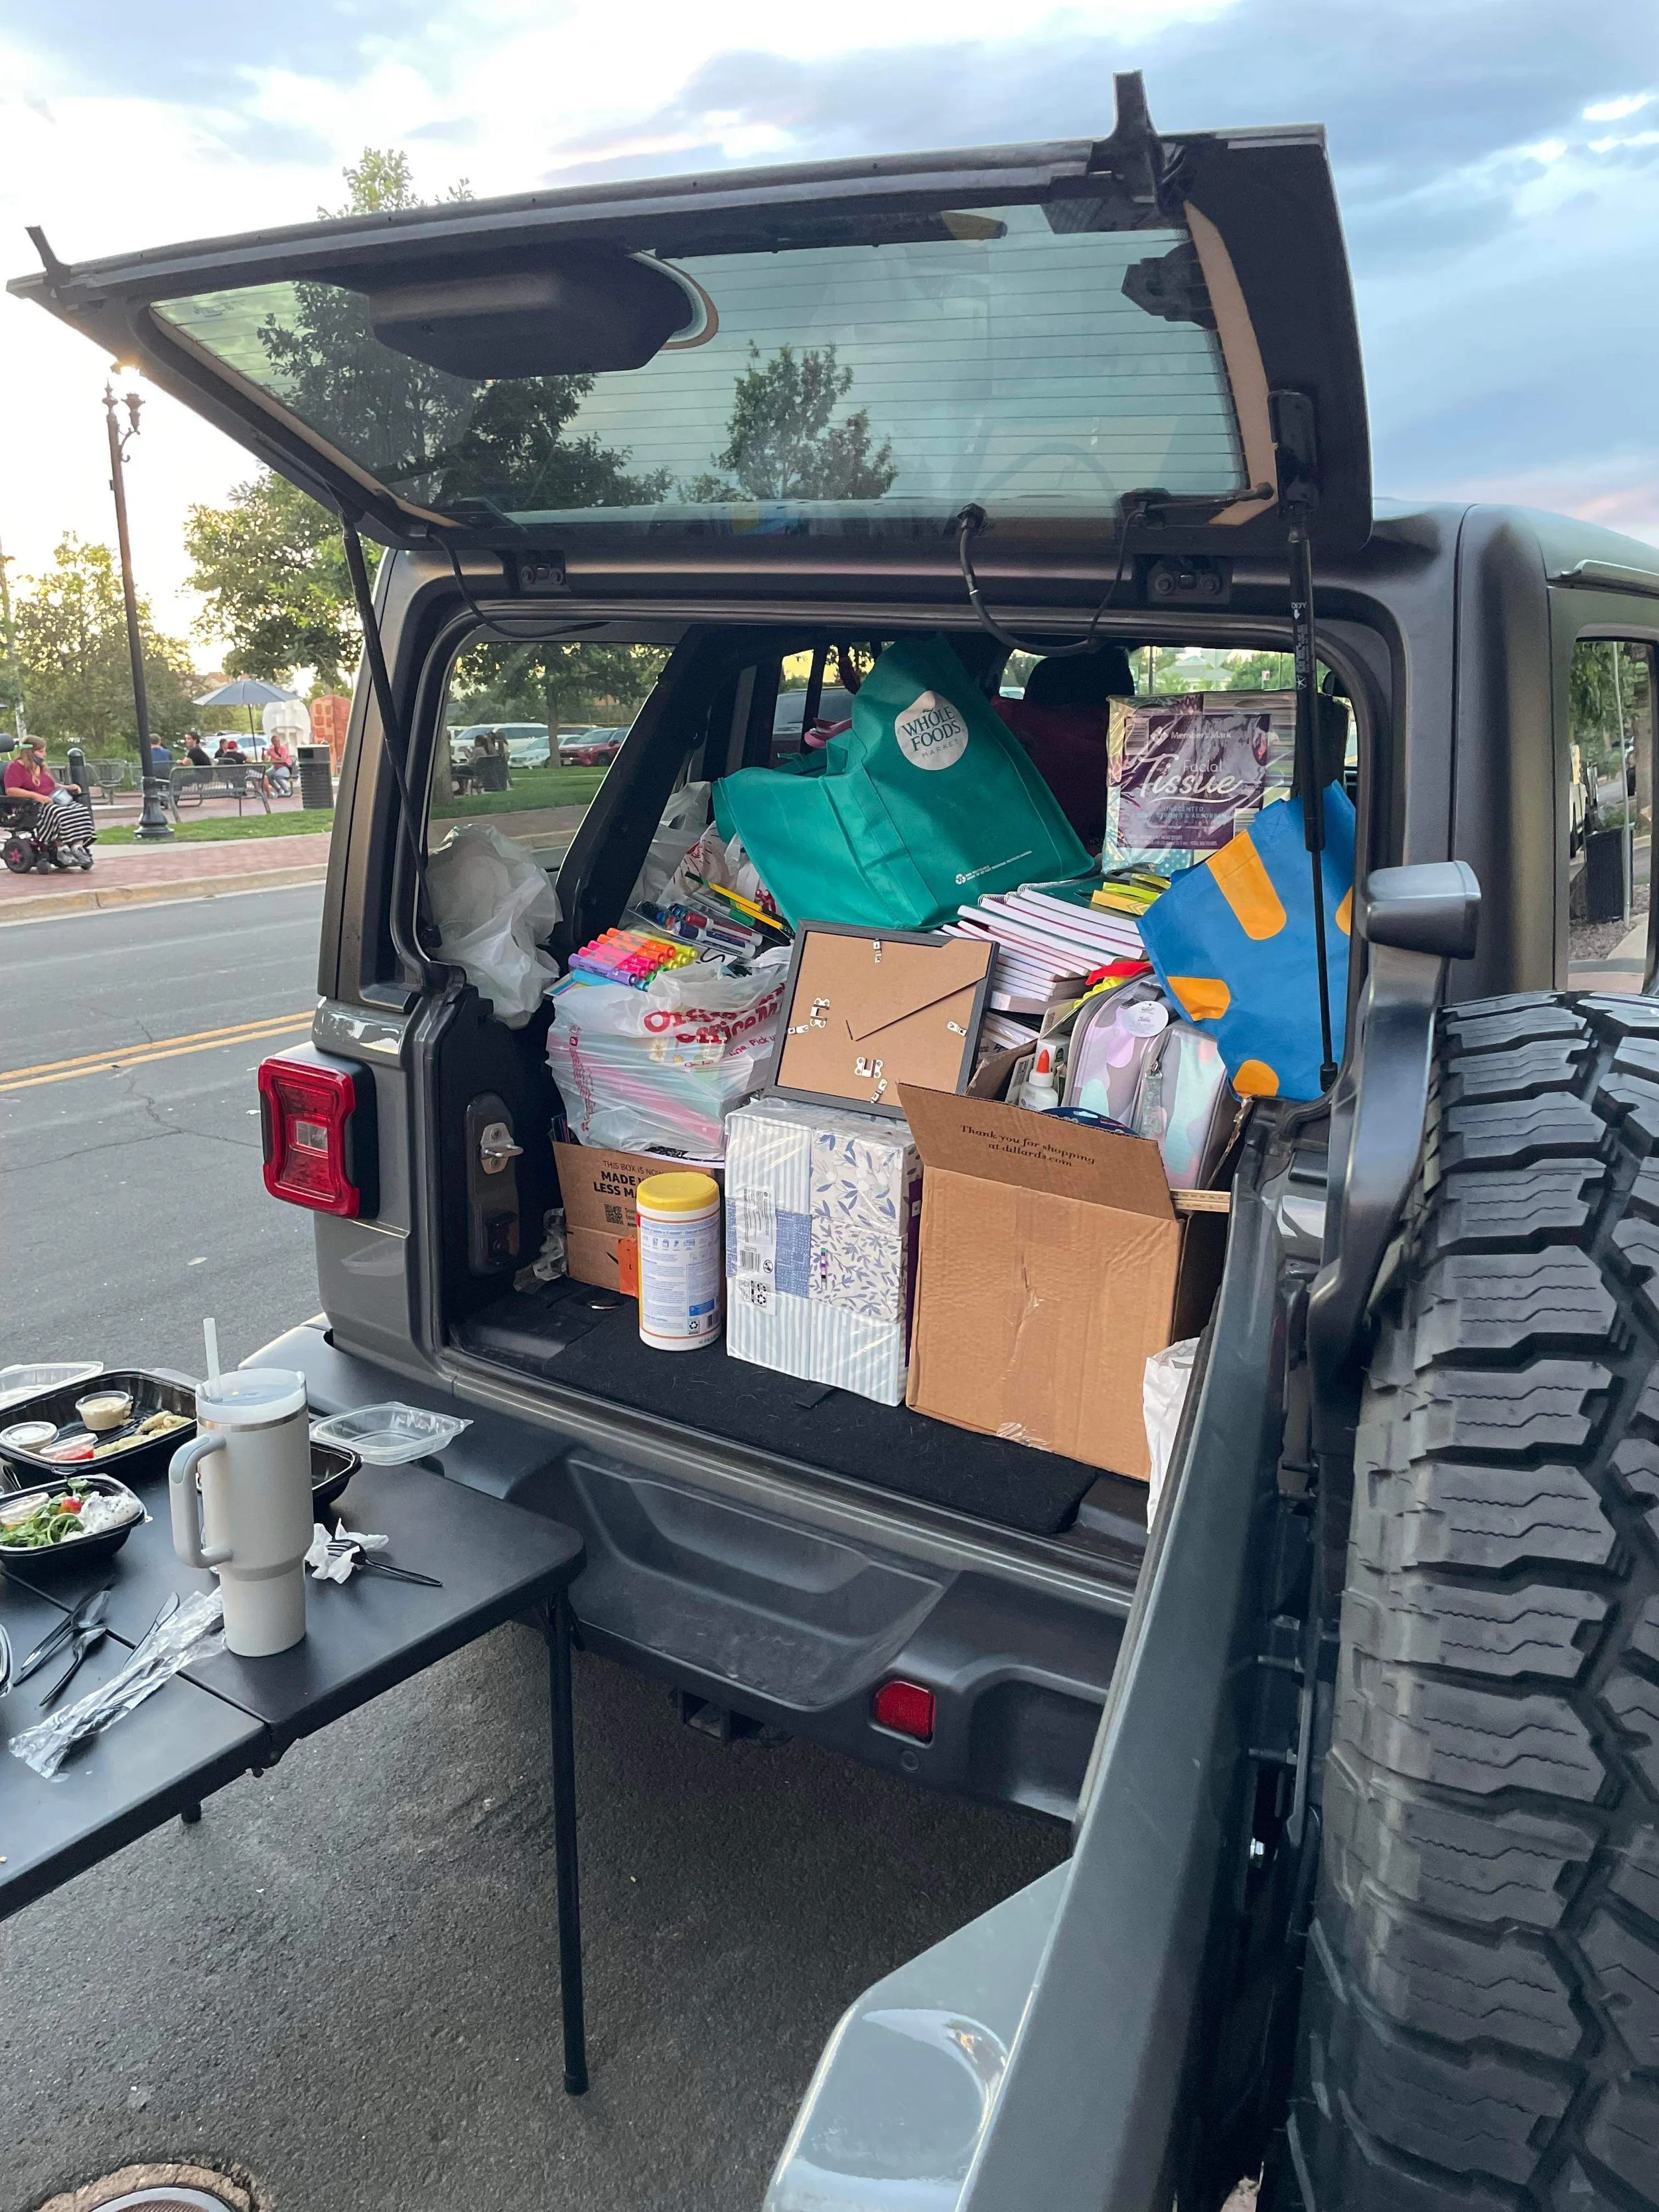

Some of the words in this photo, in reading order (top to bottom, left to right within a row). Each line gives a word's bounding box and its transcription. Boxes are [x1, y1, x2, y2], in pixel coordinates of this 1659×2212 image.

[901, 707, 954, 736] WHOLE
[910, 720, 961, 751] FOODS
[922, 739, 958, 758] MARKET
[1139, 753, 1242, 798] Tissue
[1183, 760, 1222, 772] Facial
[751, 1036, 769, 1046] Pick
[961, 1124, 996, 1139] Thank
[999, 1135, 1019, 1143] you
[1023, 1138, 1040, 1147] for
[1043, 1143, 1095, 1165] shopping
[1003, 1145, 1072, 1167] dillards.com
[603, 1161, 619, 1169] THIS
[621, 1163, 636, 1172] BOX
[593, 1181, 621, 1195] LESS
[601, 1171, 636, 1186] MADE
